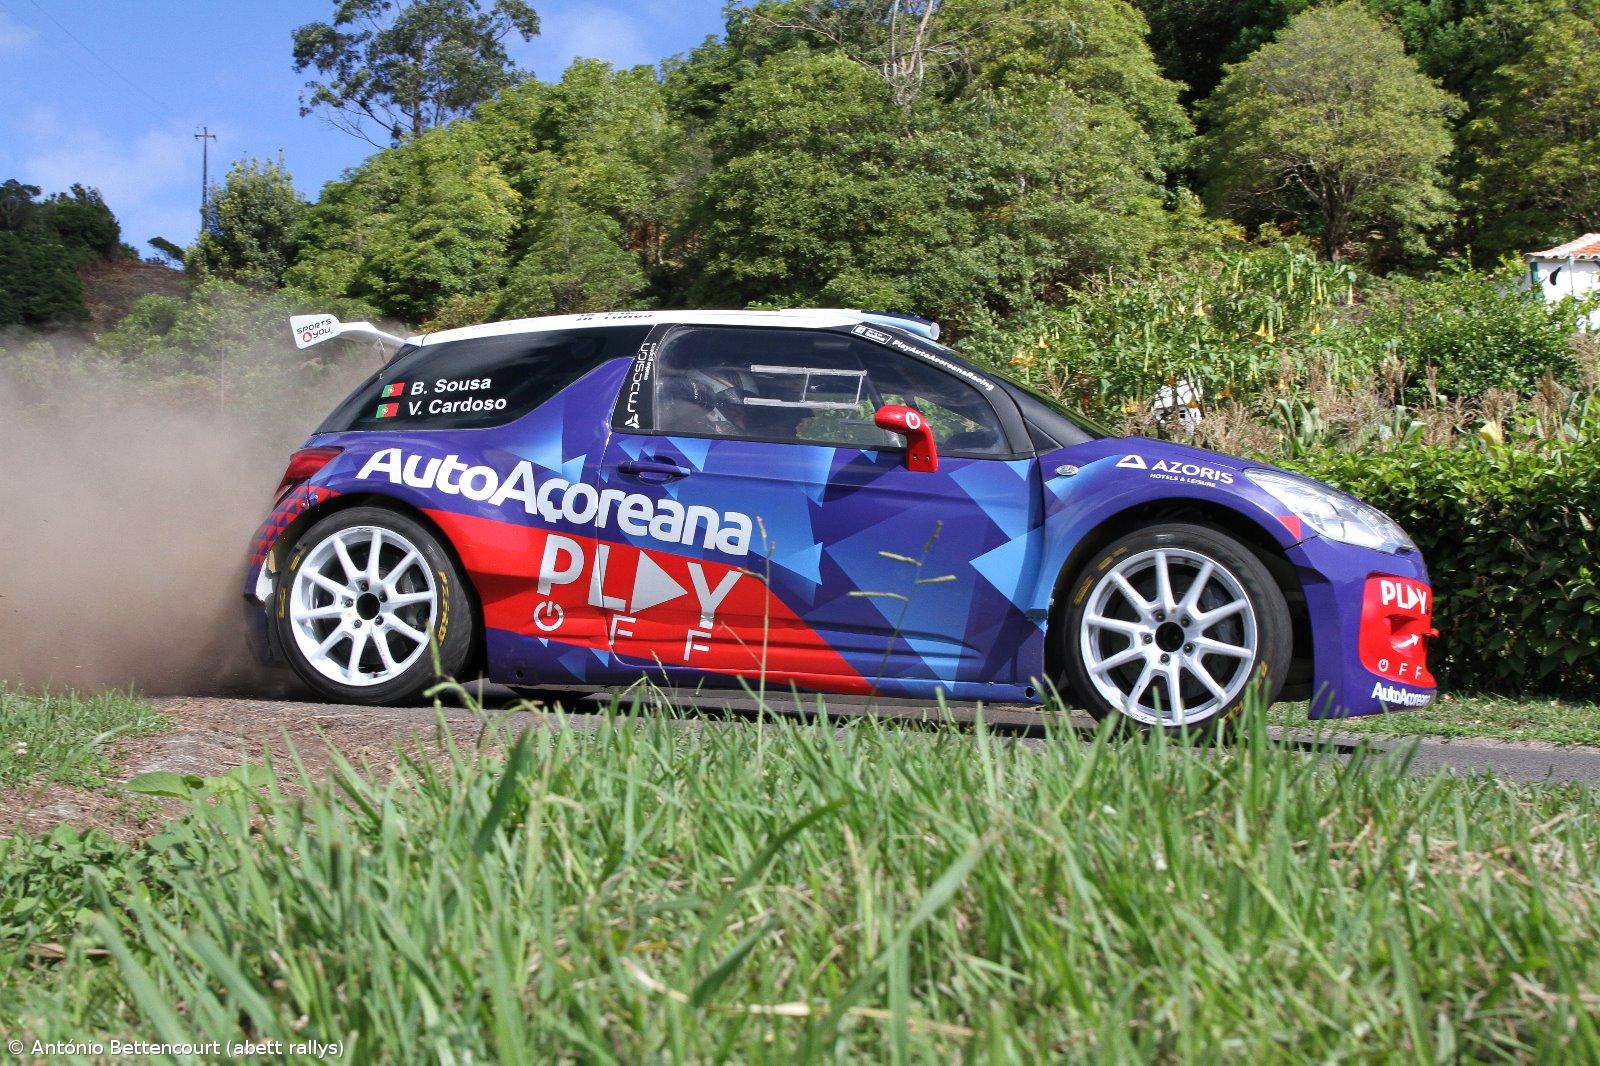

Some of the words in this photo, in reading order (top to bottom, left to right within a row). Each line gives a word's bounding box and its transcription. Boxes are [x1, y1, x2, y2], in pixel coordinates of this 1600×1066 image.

[297, 319, 331, 334] SPORTS
[410, 382, 428, 395] B.
[435, 377, 491, 393] Sousa
[408, 401, 422, 415] V.
[428, 397, 507, 414] Cardoso
[1150, 473, 1178, 482] HOTELS
[1187, 478, 1216, 488] LEISURE
[1151, 459, 1234, 484] AZORIS
[355, 448, 753, 556] AutoAçoreana
